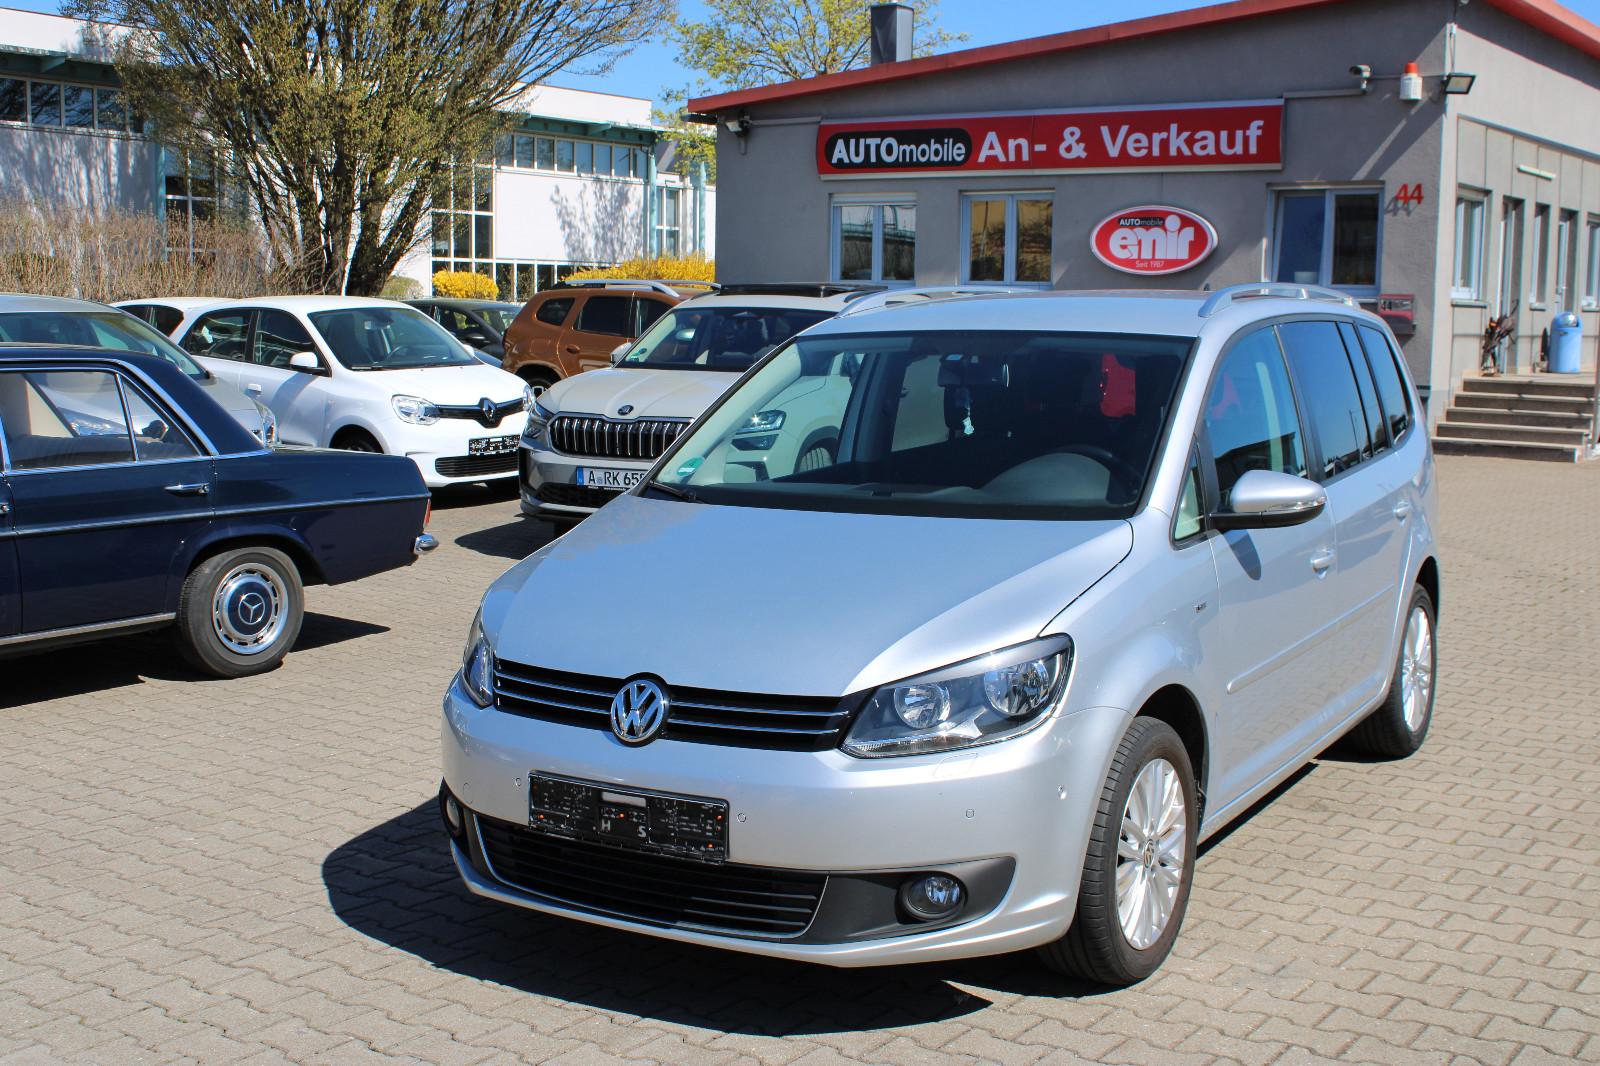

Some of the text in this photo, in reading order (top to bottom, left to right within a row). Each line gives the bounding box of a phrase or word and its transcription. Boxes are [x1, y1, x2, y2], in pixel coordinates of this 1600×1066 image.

[831, 120, 1264, 164] AUTOmobile An- & Verkauf
[1395, 183, 1423, 205] 44
[1109, 214, 1195, 260] emir
[1119, 218, 1164, 227] AUTOmobile
[588, 470, 596, 484] A
[604, 471, 621, 486] RK
[611, 679, 664, 742] VW
